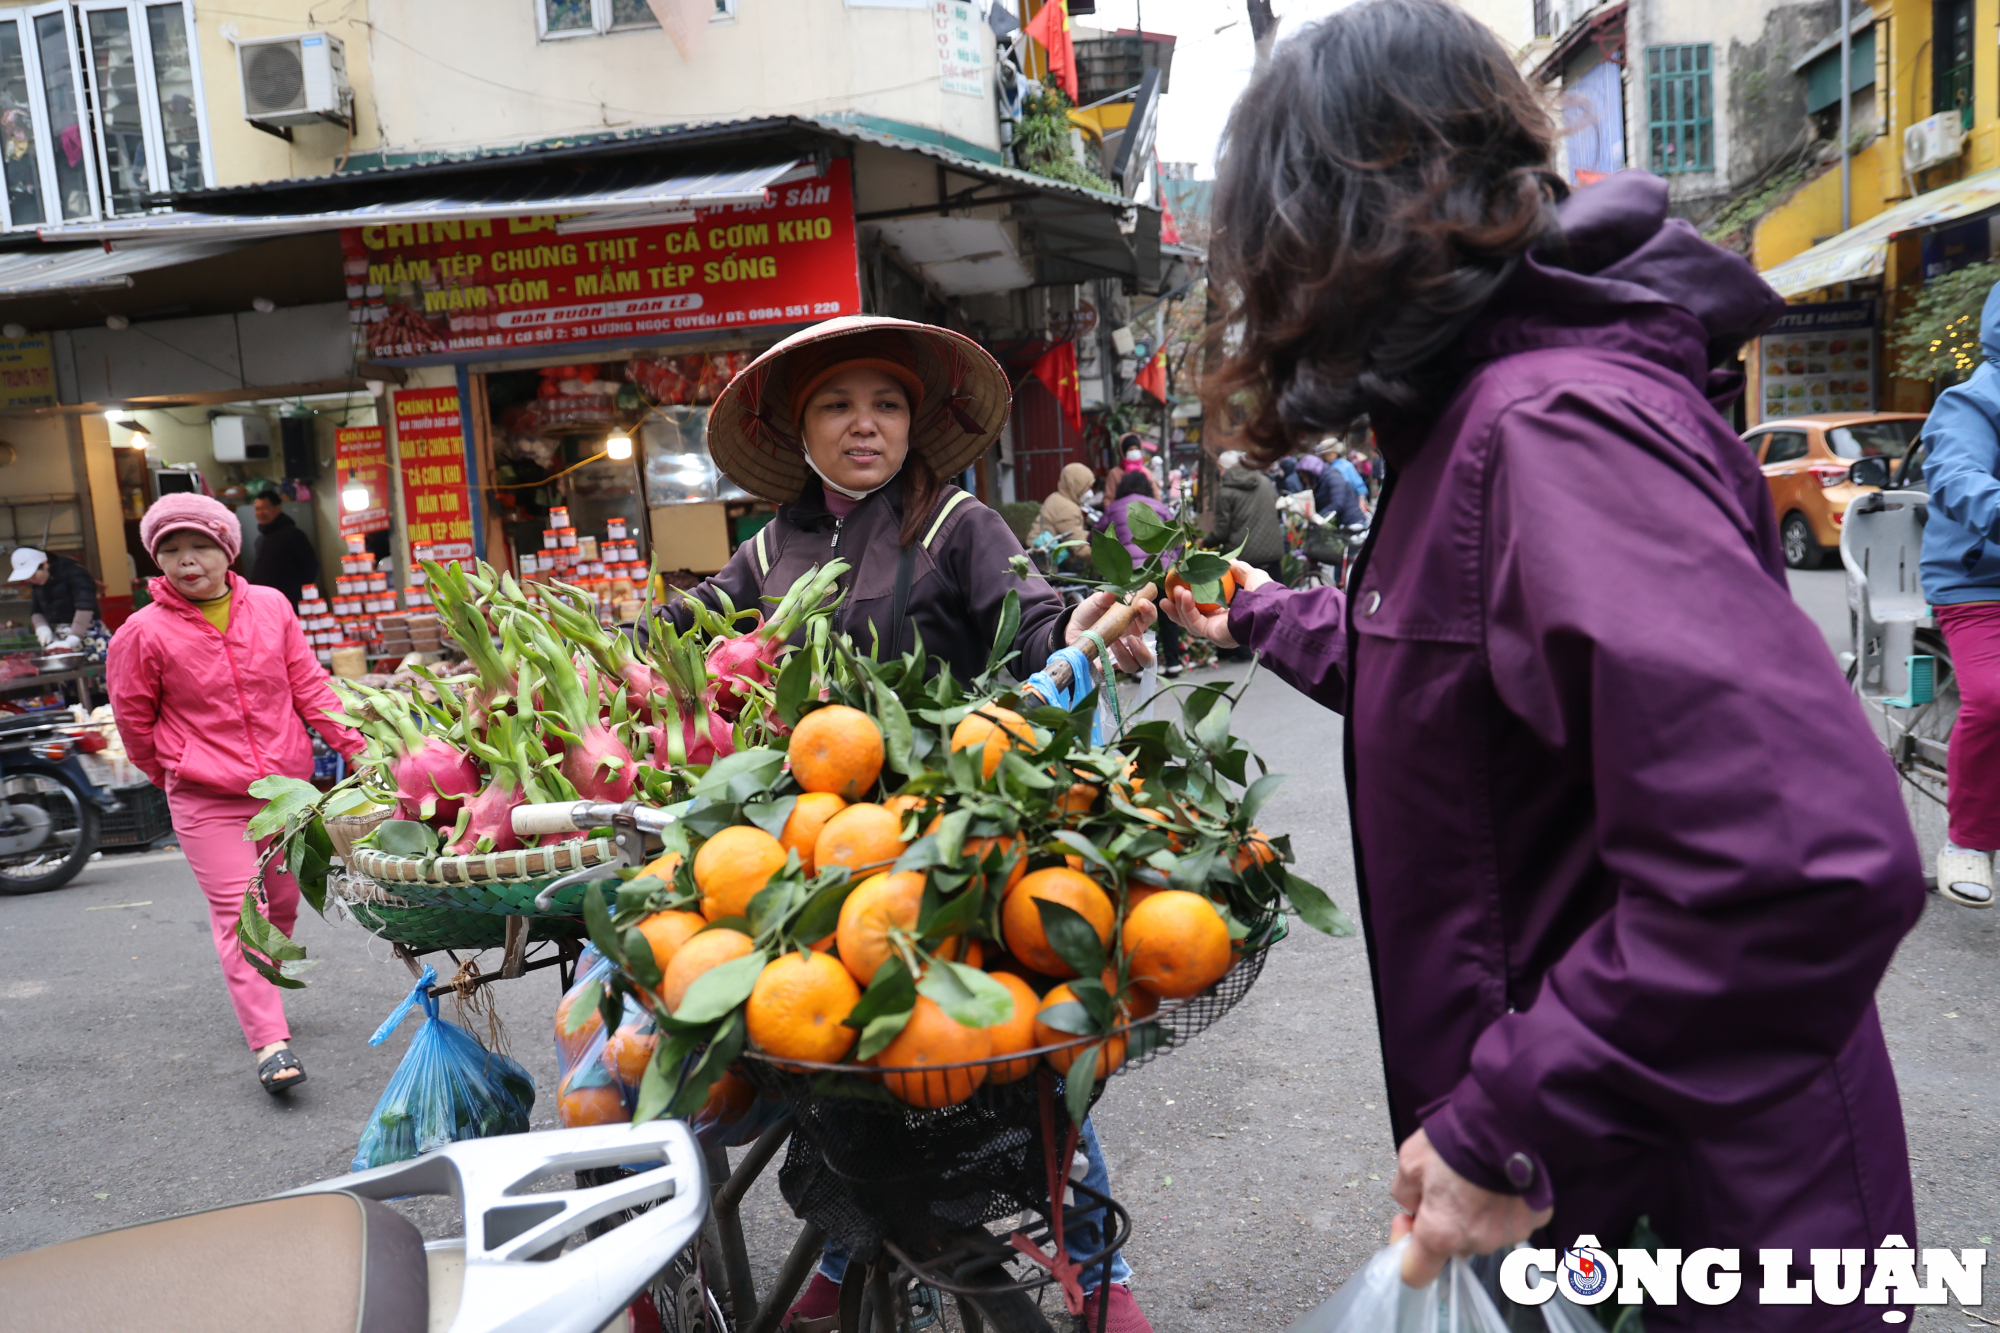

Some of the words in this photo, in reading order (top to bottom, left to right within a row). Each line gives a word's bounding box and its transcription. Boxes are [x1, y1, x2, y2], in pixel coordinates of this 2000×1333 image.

[785, 182, 831, 206] SẢN
[368, 254, 431, 285] MẮM
[438, 251, 482, 277] TÉP
[490, 243, 578, 273] CHƯNG
[583, 237, 639, 264] THỊT
[665, 226, 701, 254] CÁ
[708, 222, 769, 250] CƠM
[777, 216, 832, 243] KHO
[424, 281, 488, 313] MẮM
[494, 278, 549, 303] TÔM
[575, 265, 640, 297] MẮM
[647, 261, 695, 289] TÉP
[704, 252, 777, 283] SỐNG
[510, 311, 546, 325] BÁN
[553, 306, 602, 321] BUÔN
[625, 298, 662, 313] BÁN
[571, 326, 588, 337] 30
[636, 319, 670, 334] NGỌC
[749, 308, 782, 320] 0984
[785, 304, 809, 316] 551
[814, 301, 840, 313] 220
[397, 397, 434, 416] CHÍNH
[436, 396, 459, 413] LAN
[443, 465, 461, 484] KHO
[431, 518, 448, 540] TÉP
